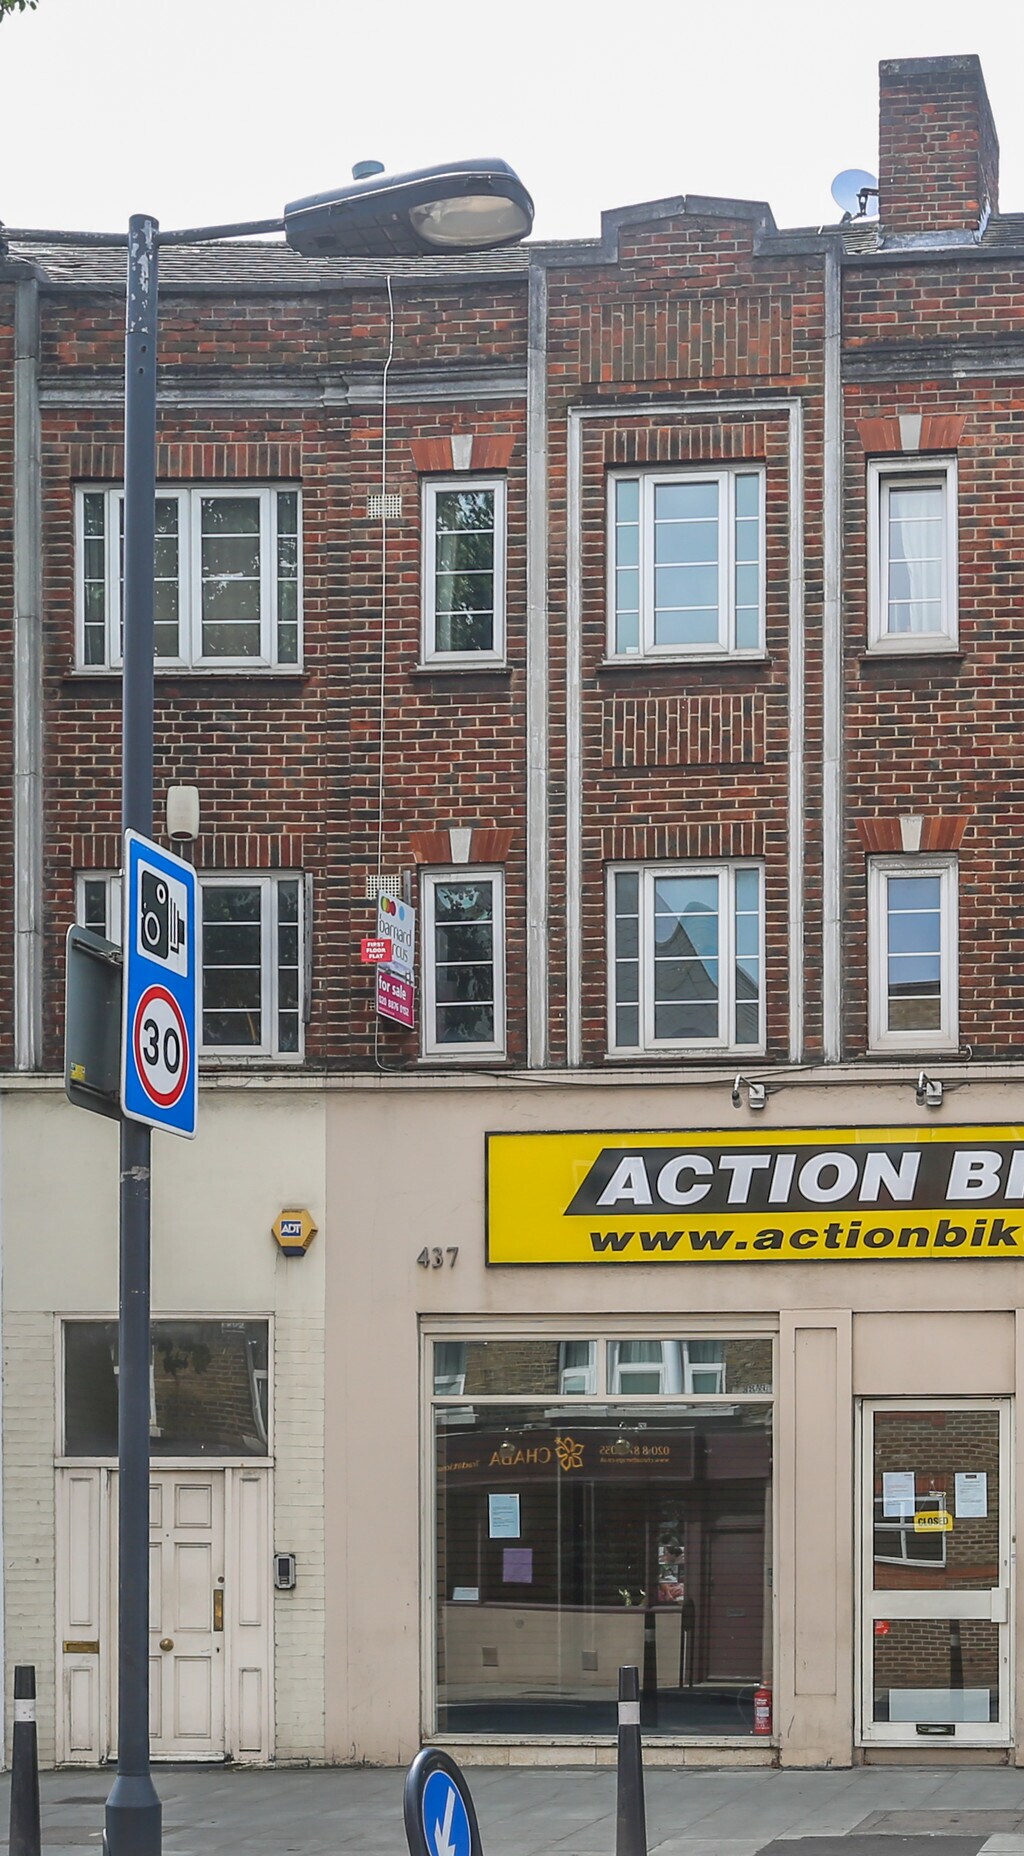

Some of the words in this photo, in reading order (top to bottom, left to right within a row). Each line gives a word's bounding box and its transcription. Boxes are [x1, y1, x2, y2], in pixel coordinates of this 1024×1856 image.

[379, 915, 412, 947] barnard
[378, 975, 391, 993] for
[391, 984, 407, 1001] sale
[143, 1018, 180, 1074] 30
[596, 1151, 922, 1206] ACTION
[281, 1222, 302, 1235] ADT
[416, 1246, 459, 1269] 437
[918, 1517, 949, 1526] CLOSED
